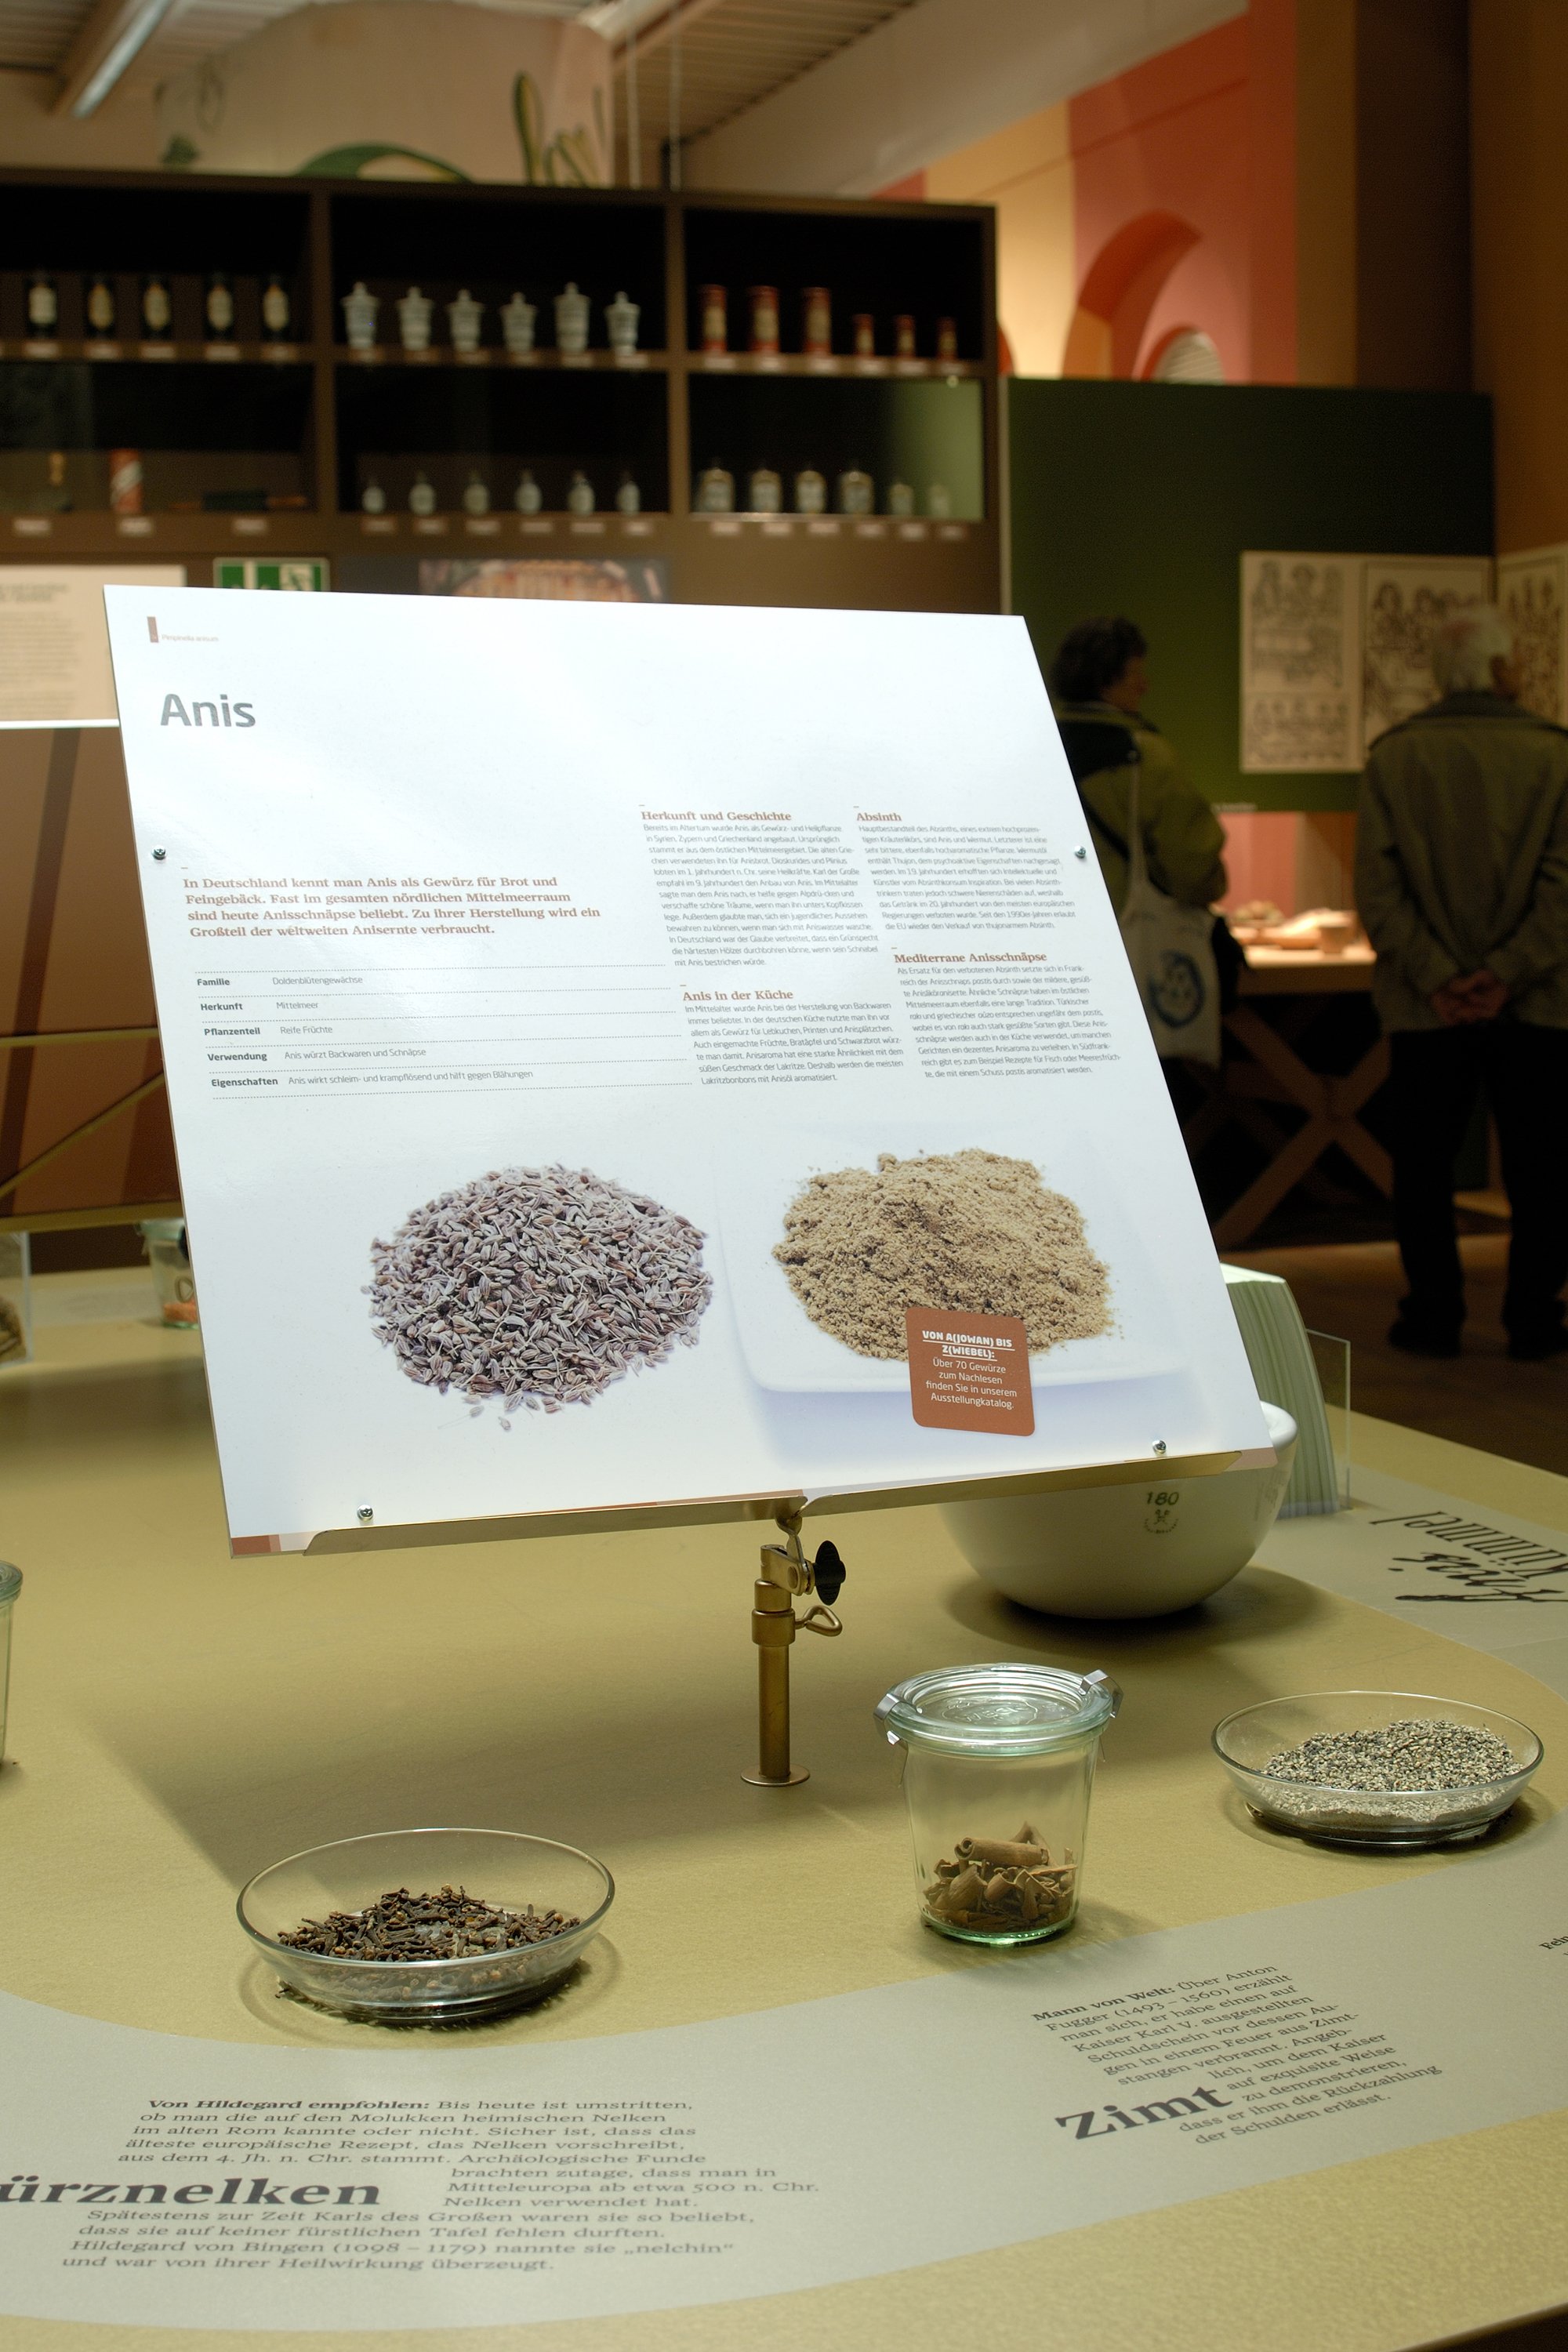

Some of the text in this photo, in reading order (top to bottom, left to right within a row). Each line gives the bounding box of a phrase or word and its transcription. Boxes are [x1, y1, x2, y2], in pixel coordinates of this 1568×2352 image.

[160, 694, 256, 728] Anis
[641, 811, 792, 821] Herkunft und Geschichte
[856, 812, 902, 822] Absinth
[183, 879, 199, 888] In
[202, 878, 288, 888] Deutschland
[291, 878, 329, 887] kennt
[367, 877, 397, 887] Anis
[401, 877, 419, 887] als
[423, 877, 474, 887] Gewürz
[477, 877, 496, 887] für
[499, 877, 529, 887] Brot
[532, 877, 557, 887] und
[185, 892, 571, 906] Feingebäck. Fast im gesamten nördlichen Mittelmeerraum
[187, 907, 601, 921] sind heute Anisschnäpse beliebt. Zu ihrer Herstellung wird ein
[190, 924, 495, 937] Großteil der weltweiten Anisernte verbraucht.
[893, 952, 1047, 964] Mediterrane Anisschnäpse
[197, 978, 230, 986] Familie
[272, 976, 363, 985] Doldenblütengewächse
[683, 989, 793, 1001] Anis in der Küche
[204, 1027, 260, 1036] Pflanzenteil
[303, 1025, 333, 1034] Früchte
[207, 1053, 267, 1062] Verwendung
[303, 1051, 327, 1059] würzt
[328, 1050, 372, 1058] Backwaren
[388, 1048, 426, 1058] Schnäpse
[211, 1077, 278, 1088] Eigenschaften
[379, 1073, 433, 1083] krampflösend
[466, 1073, 492, 1081] gegen
[492, 1070, 533, 1080] Blähungen
[701, 1076, 757, 1085] Lakritzbonbons
[922, 1330, 1012, 1347] VON A(JOWAN) BIS
[942, 1345, 994, 1359] Z(WIEBEL):
[933, 1357, 1006, 1374] Über 70 Gewürze
[959, 1372, 1003, 1385] Nachlesen
[925, 1381, 1017, 1397] finden Sie in unserem
[931, 1392, 1014, 1410] Ausstellungkatalog.
[1146, 1491, 1179, 1505] 180
[1031, 1966, 1279, 2021] Mann von Welt: Über Anton
[1044, 2013, 1109, 2031] Fugger
[1114, 2002, 1165, 2017] (1493
[1180, 1988, 1230, 2003] 1560)
[1234, 1975, 1293, 1991] erzählt
[1059, 2029, 1102, 2042] man
[1105, 2020, 1149, 2032] sich,
[1169, 2005, 1216, 2017] habe
[1219, 1994, 1272, 2008] einen
[1269, 1985, 1298, 1997] auf
[1073, 2035, 1132, 2052] Kaiser
[1134, 2024, 1178, 2039] Karl
[1201, 1997, 1314, 2025] ausgestellten
[1087, 2005, 1339, 2063] Schuldschein vor dessen Au-
[1103, 2013, 1359, 2075] gen in einem Feuer aus Zimt-
[1118, 2029, 1352, 2085] stangen verbrannt. Angeb-
[194, 2100, 303, 2111] Hildegard
[308, 2100, 430, 2111] empfohlen:
[576, 2101, 691, 2110] umstritten,
[1179, 2065, 1443, 2132] dass er ihm die Rückzahlung
[140, 2113, 166, 2122] ob
[226, 2113, 257, 2122] die
[303, 2114, 342, 2122] den
[350, 2114, 454, 2122] Molukken
[463, 2114, 583, 2122] heimischen
[593, 2114, 666, 2122] Nelken
[1055, 2085, 1232, 2140] Zimt
[1196, 2094, 1392, 2144] der Schulden erlässt.
